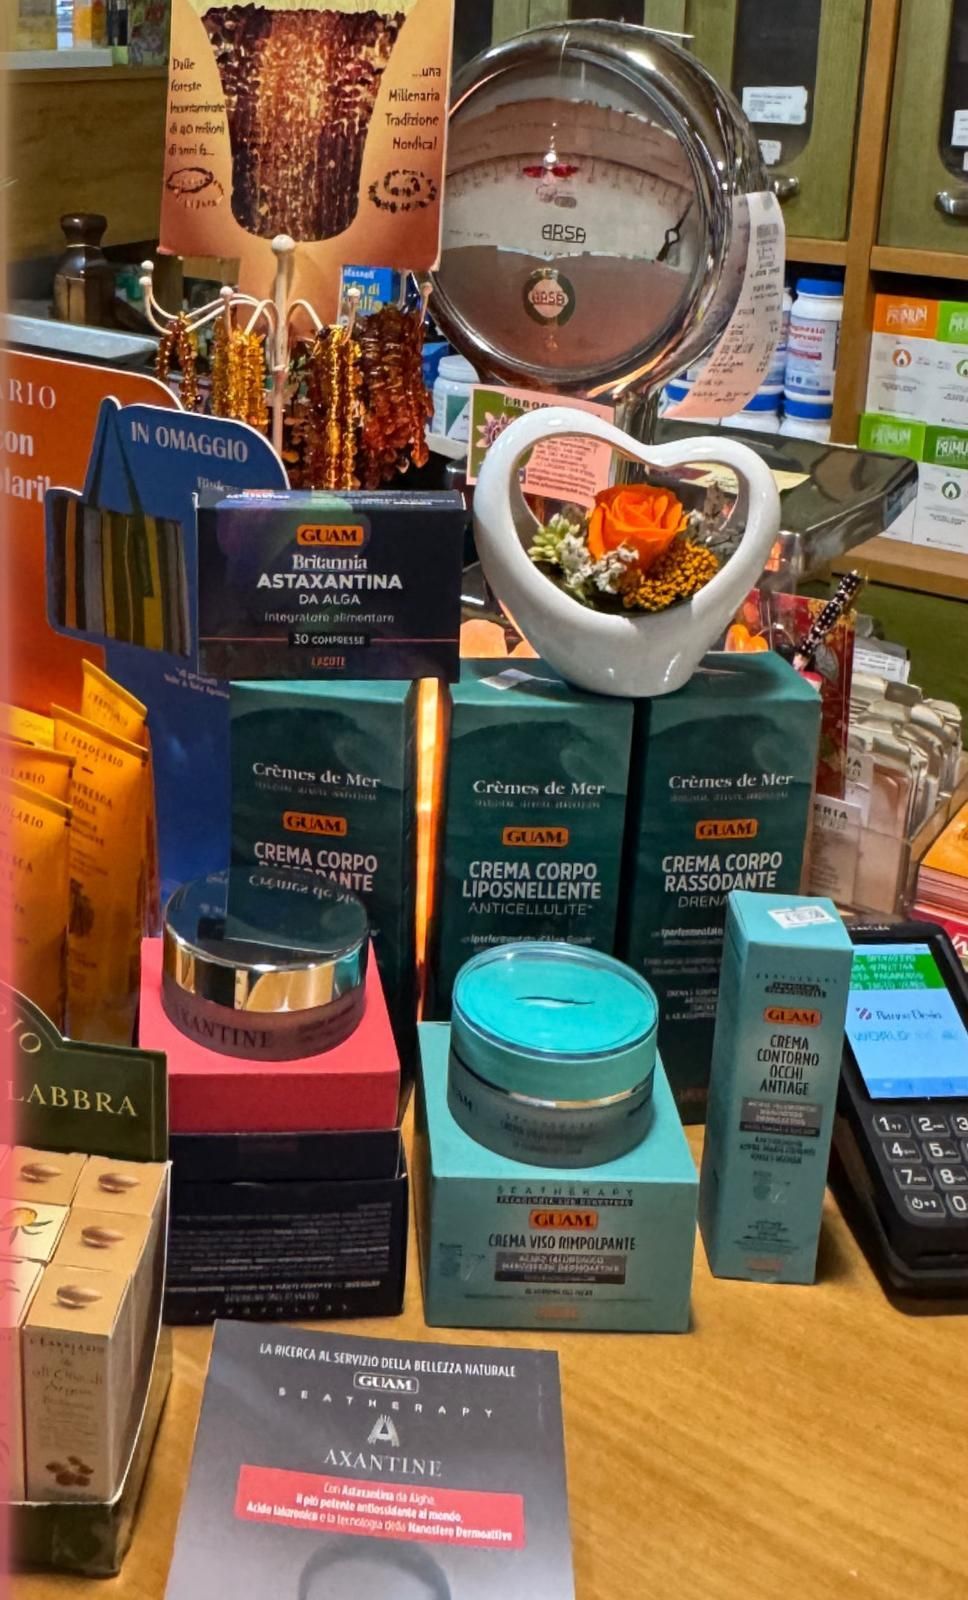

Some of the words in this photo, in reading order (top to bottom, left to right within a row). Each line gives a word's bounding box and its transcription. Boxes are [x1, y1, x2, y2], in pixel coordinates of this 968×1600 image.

[388, 87, 441, 103] Millenaria
[385, 111, 440, 127] Tradizione
[392, 134, 438, 151] Nordica!
[542, 224, 586, 244] ARSA
[0, 430, 34, 457] on
[131, 421, 149, 443] IN
[155, 426, 248, 463] OMAGGIO
[300, 527, 358, 543] GUAM
[292, 554, 368, 571] Britannia
[256, 573, 403, 590] ASTAXANTINA
[299, 594, 319, 606] DA
[322, 594, 361, 606] ALGA
[293, 633, 309, 645] 30
[252, 761, 316, 782] Crèmes
[320, 770, 342, 785] de
[346, 772, 381, 789] Mer
[668, 774, 732, 789] Crèmes
[736, 773, 757, 788] de
[761, 773, 794, 787] Mer
[473, 779, 539, 795] Crèmes
[544, 781, 566, 795] de
[570, 782, 606, 796] Mer
[286, 815, 343, 833] GUAM
[699, 822, 751, 837] GUAM
[507, 830, 565, 844] GUAM
[253, 842, 312, 867] CREMA
[316, 849, 378, 873] CORPO
[661, 855, 721, 873] CREMA
[725, 852, 782, 871] CORPO
[469, 861, 531, 880] CREMA
[535, 862, 597, 881] CORPO
[462, 880, 602, 900] LIPOSNELLENTE
[665, 871, 776, 892] RASSODANTE
[770, 1034, 809, 1051] CREMA
[757, 1048, 820, 1067] CONTORNO
[769, 1064, 804, 1080] OCCHI
[759, 1078, 809, 1096] ANTIAGE
[8, 1079, 139, 1118] LABBRA
[879, 1117, 890, 1131] 1
[918, 1117, 933, 1131] 2
[956, 1116, 968, 1131] 3
[892, 1142, 903, 1157] 4
[929, 1143, 943, 1157] 5
[901, 1169, 912, 1184] 7
[940, 1169, 955, 1184] 8
[953, 1195, 967, 1211] 0
[534, 1213, 593, 1227] GUAM
[489, 1234, 526, 1248] CREMA
[530, 1235, 555, 1249] VISO
[559, 1236, 636, 1251] RIMPOLPANTE
[260, 1343, 272, 1355] LA
[274, 1345, 316, 1361] RICERCA
[319, 1350, 332, 1362] AL
[333, 1352, 379, 1367] SERVIZIO
[381, 1356, 411, 1371] DELLA
[414, 1360, 462, 1374] BELLEZZA
[465, 1364, 516, 1378] NATURALE
[358, 1375, 414, 1391] GUAM
[323, 1449, 442, 1478] AXANTINE
[324, 1481, 341, 1494] Con
[341, 1485, 394, 1502] Astaxantina
[246, 1501, 272, 1514] Acido
[319, 1513, 326, 1523] e
[327, 1513, 336, 1524] la
[337, 1514, 383, 1531] tecnologia
[319, 1497, 355, 1512] potente
[418, 1508, 428, 1519] al
